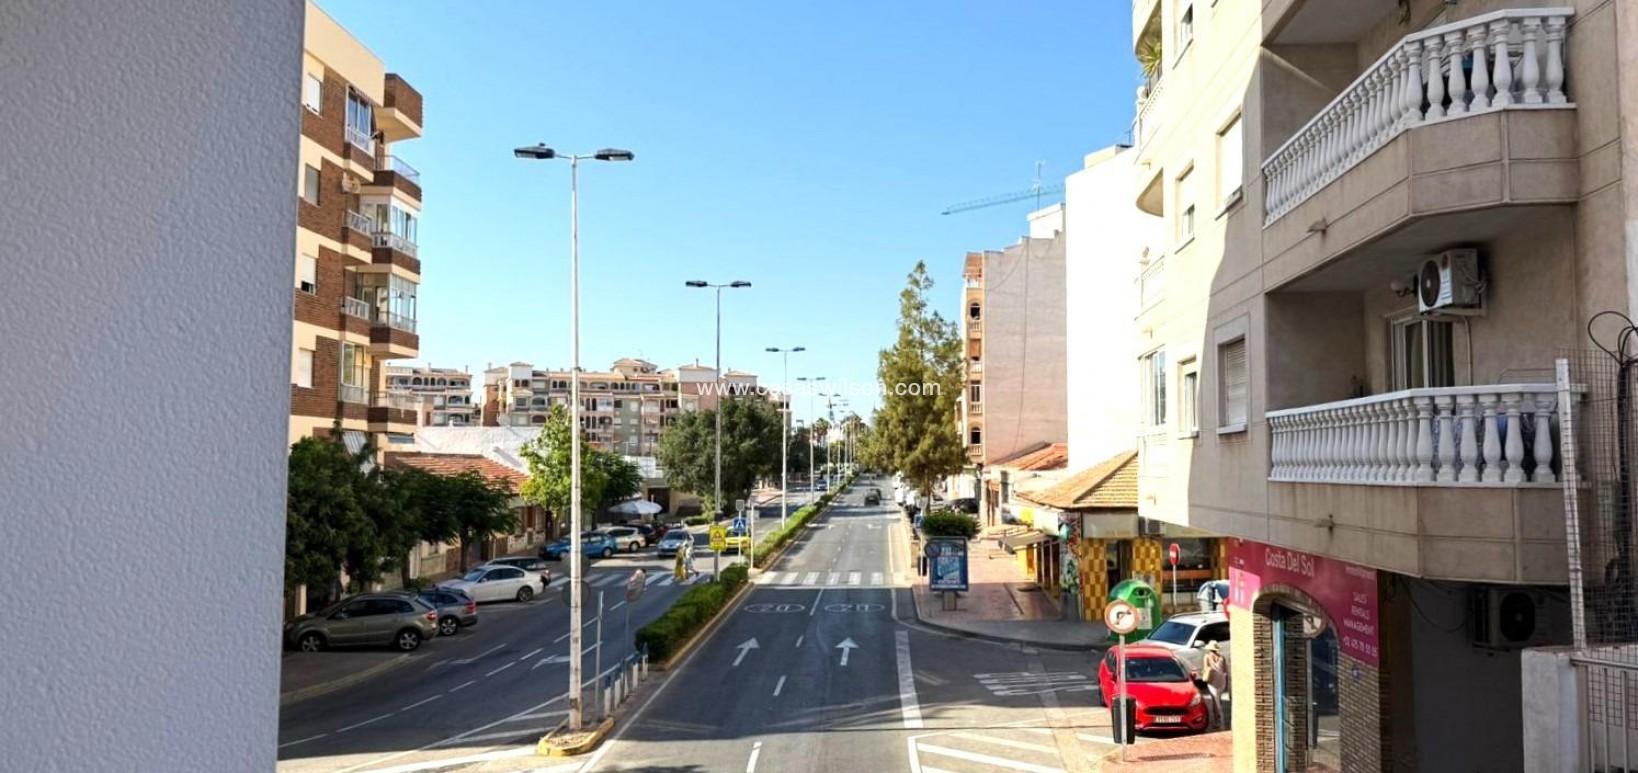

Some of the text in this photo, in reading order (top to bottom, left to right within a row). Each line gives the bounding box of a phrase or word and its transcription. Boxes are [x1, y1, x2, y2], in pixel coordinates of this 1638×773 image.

[1265, 548, 1314, 577] Costa Del Sol
[1343, 618, 1375, 635] MANAGEMENT
